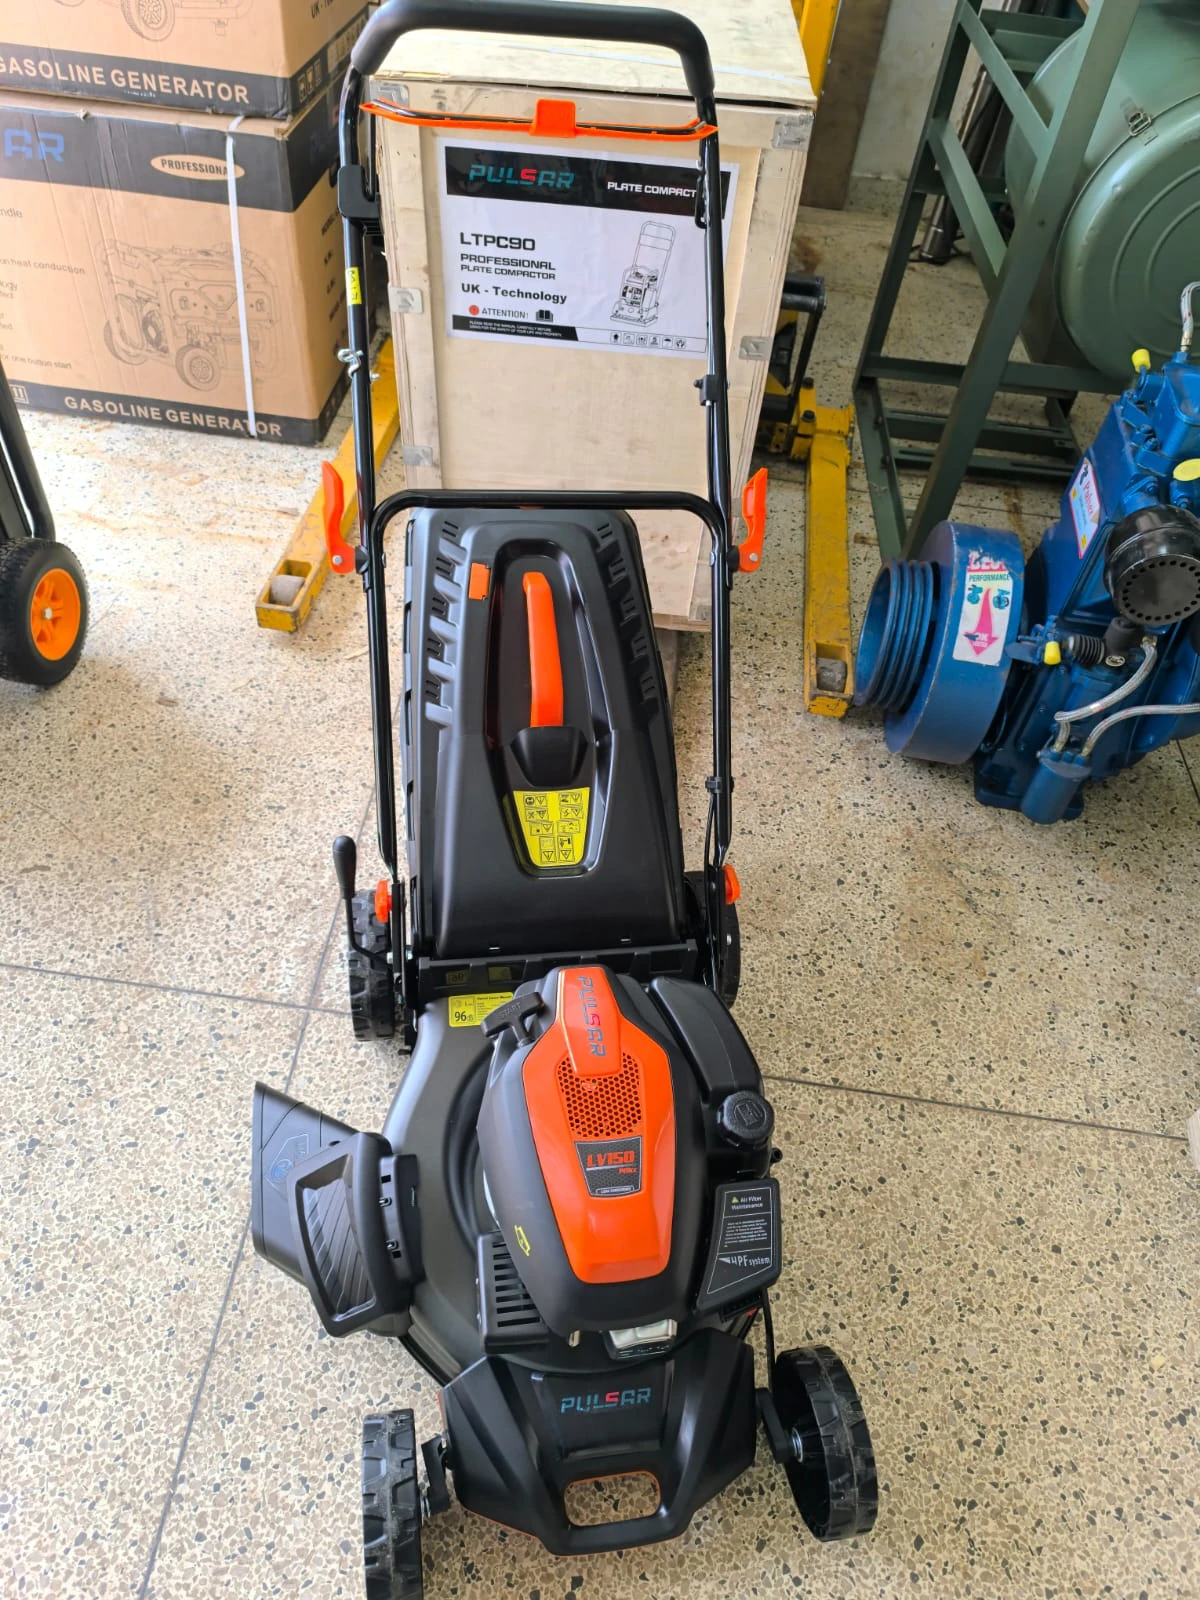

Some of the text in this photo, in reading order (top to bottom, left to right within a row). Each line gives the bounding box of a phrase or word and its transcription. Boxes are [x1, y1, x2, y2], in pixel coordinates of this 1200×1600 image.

[110, 68, 250, 104] GENERATOR
[160, 158, 228, 176] PROFESSIONA
[468, 164, 575, 189] PULSAR
[607, 181, 698, 199] PLATE COMPACT
[459, 231, 536, 251] LTPC90
[460, 253, 556, 271] PROFESSIONAL
[460, 264, 556, 281] PLATE COMPACTOR
[461, 282, 481, 294] UK
[492, 285, 568, 305] Technology
[63, 395, 283, 437] GASOLINE GENERATOR
[968, 573, 1010, 582] PERFORMANCE
[454, 1010, 467, 1022] 96
[577, 975, 606, 1057] PULSAR
[749, 1256, 770, 1267] system
[561, 1387, 652, 1414] PULSAR
